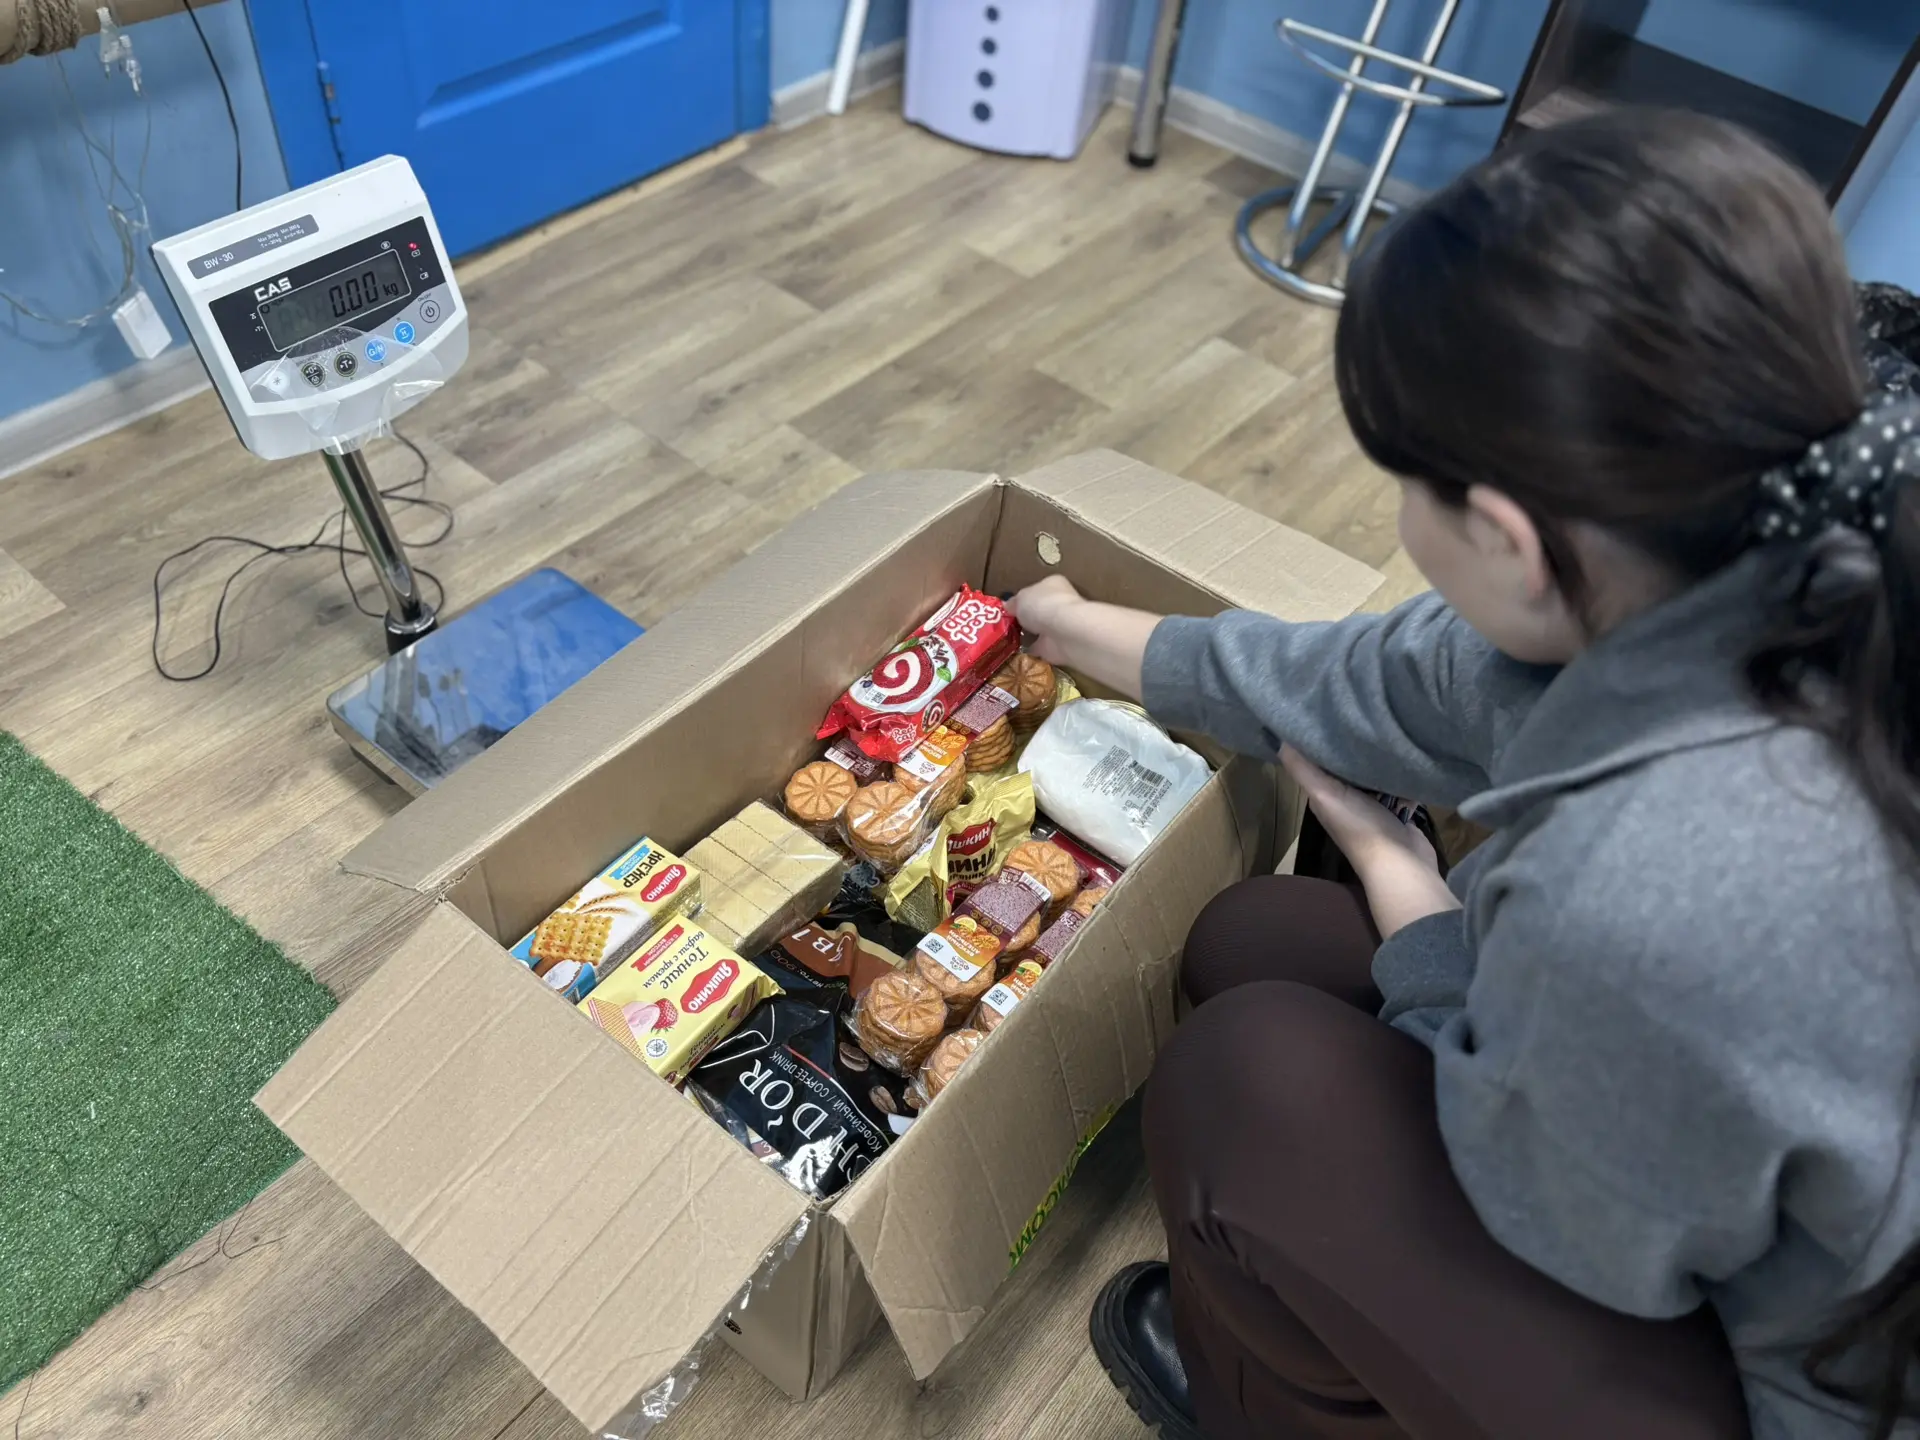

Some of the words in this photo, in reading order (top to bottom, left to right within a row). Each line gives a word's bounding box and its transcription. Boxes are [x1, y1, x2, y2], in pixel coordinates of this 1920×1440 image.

[254, 277, 292, 301] CAS
[329, 271, 379, 318] 0.00
[383, 281, 399, 297] kg
[950, 606, 1001, 644] Red
[892, 722, 917, 738] Red
[623, 850, 665, 888] КРЕКЕР
[680, 931, 705, 956] вафли
[643, 960, 674, 989] кремом
[662, 947, 709, 990] Тонкие
[769, 1050, 798, 1074] DRINK
[794, 1066, 830, 1097] COFFEE
[832, 1098, 882, 1153] КОФЕЙНЫЙ
